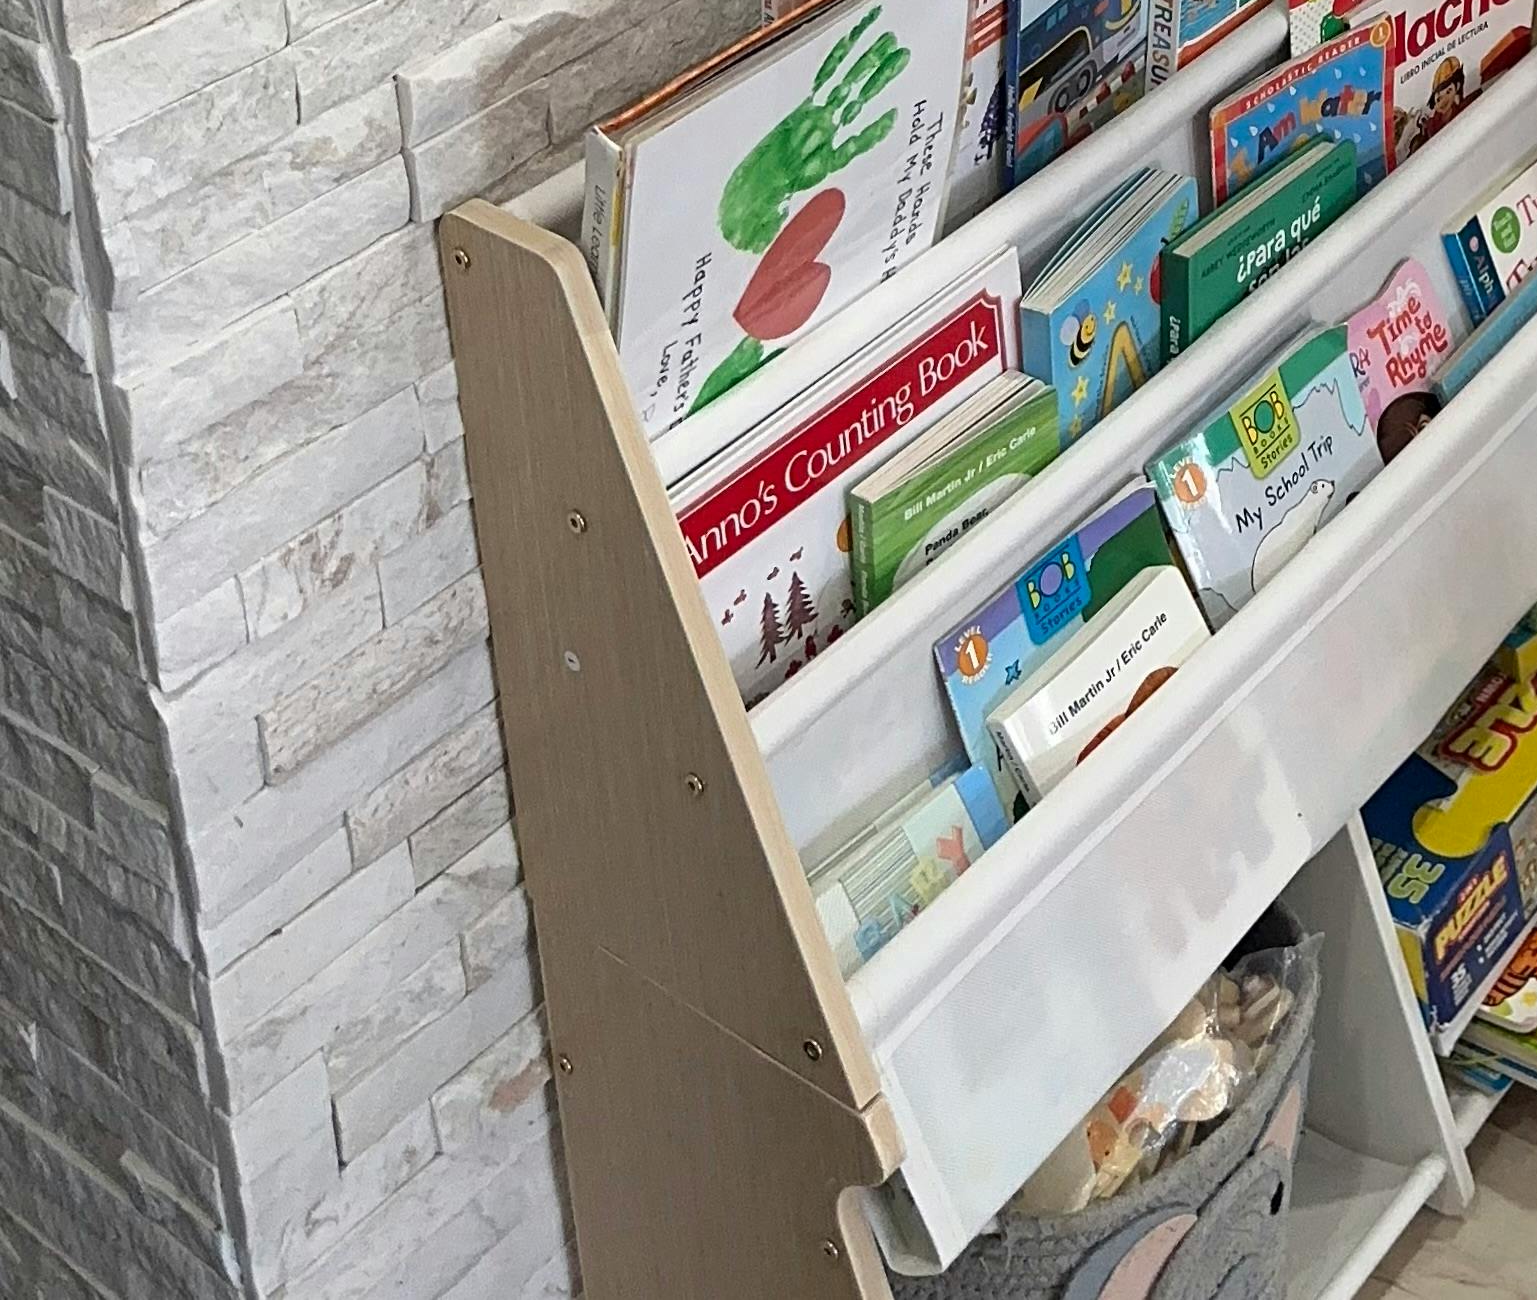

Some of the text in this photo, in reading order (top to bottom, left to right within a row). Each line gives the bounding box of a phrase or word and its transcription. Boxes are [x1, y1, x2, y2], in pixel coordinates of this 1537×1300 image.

[1244, 36, 1362, 111] SCHOLASTIC READER
[1400, 65, 1420, 85] LIBRO
[1420, 48, 1446, 75] INICIAL
[1457, 20, 1490, 47] LECTURA
[909, 99, 927, 146] Hold
[897, 153, 918, 185] My
[904, 112, 944, 246] These Hands
[1236, 229, 1286, 284] ¿Para
[1290, 195, 1321, 241] qué
[681, 252, 713, 328] Happy
[1367, 295, 1421, 356] Time
[1415, 311, 1433, 331] to
[1385, 323, 1448, 388] Rhyme
[684, 480, 778, 565] Anno's
[784, 381, 915, 494] Counting
[917, 323, 989, 398] Book
[1241, 390, 1285, 446] BOB
[903, 498, 924, 521] Bill
[926, 477, 962, 508] Martin
[963, 466, 978, 488] Jr
[985, 448, 1008, 469] Eric
[1008, 425, 1037, 451] Carle
[1260, 435, 1293, 470] Stories
[1182, 470, 1198, 497] 1
[1235, 435, 1334, 534] My School Trip
[924, 526, 960, 557] Panda
[1027, 553, 1074, 609] BOB
[1040, 597, 1083, 635] Stories
[965, 640, 980, 668] 1
[1068, 679, 1105, 718] Martin
[1104, 668, 1117, 686] Jr
[1121, 642, 1143, 666] Eric
[1141, 611, 1168, 643] Carle
[1388, 853, 1444, 904] 35
[1434, 855, 1509, 962] PUZZLE
